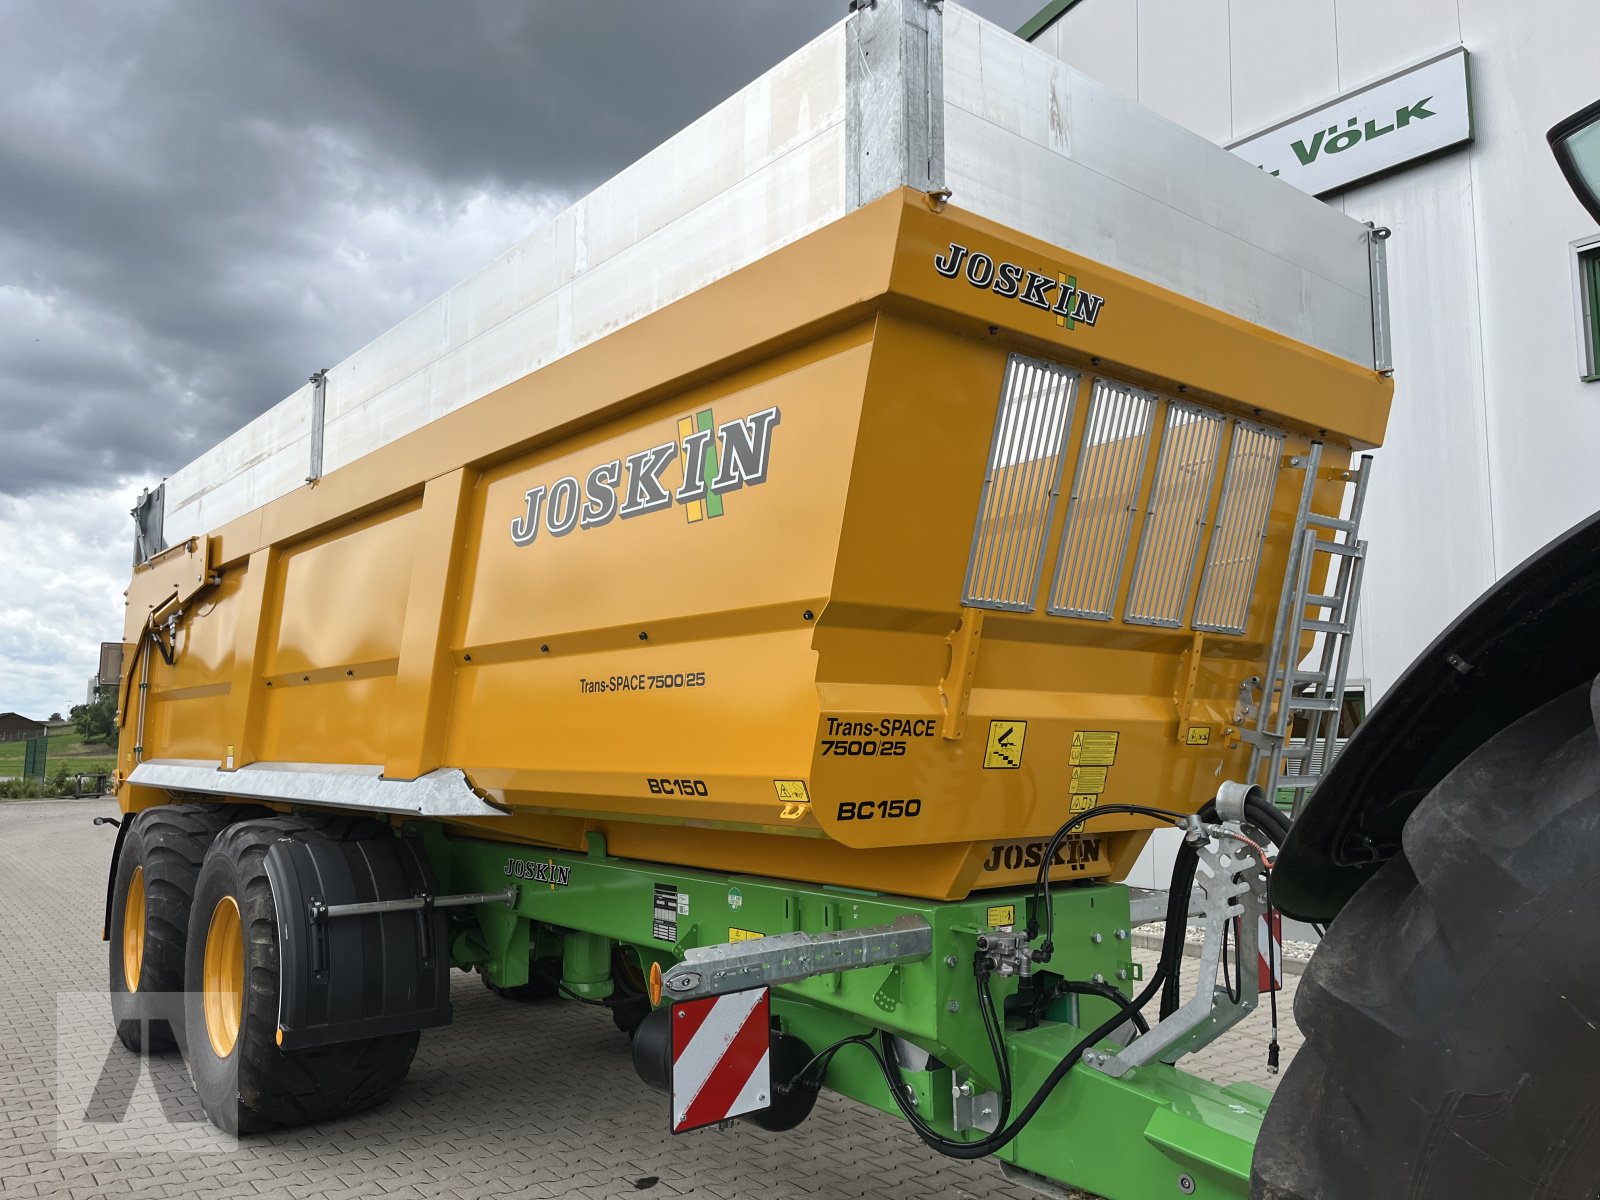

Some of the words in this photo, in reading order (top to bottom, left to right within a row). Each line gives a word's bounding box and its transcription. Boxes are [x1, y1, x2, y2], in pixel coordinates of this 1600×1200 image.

[1290, 95, 1437, 166] VÖLK
[934, 242, 1105, 327] JOSKIN
[510, 405, 781, 547] JOSKIN
[580, 674, 646, 694] Trans-SPACE
[827, 717, 936, 738] Trans-SPACE
[821, 740, 906, 757] 7500/25
[647, 778, 709, 797] BC150
[837, 798, 922, 821] BC150
[503, 858, 571, 886] JOSKIN
